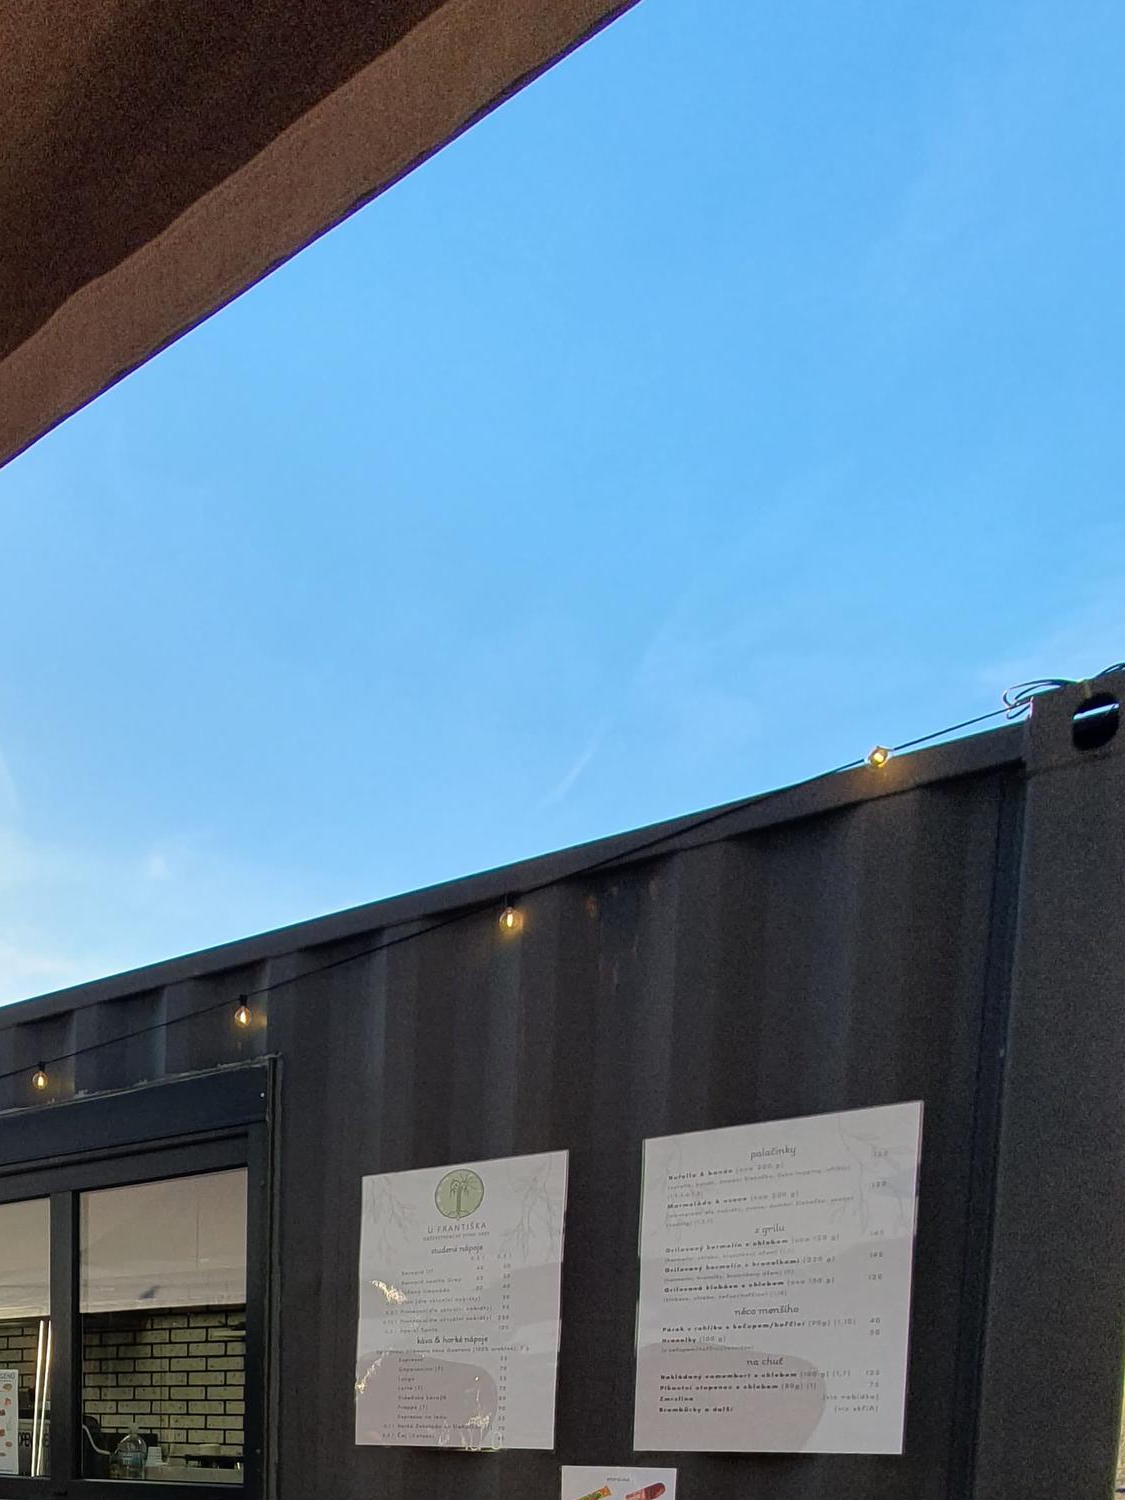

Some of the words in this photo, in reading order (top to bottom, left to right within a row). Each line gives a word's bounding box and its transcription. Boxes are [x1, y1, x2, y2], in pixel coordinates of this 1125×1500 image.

[751, 1144, 796, 1160] palačinky
[437, 1222, 487, 1233] FRANTIŠKA
[762, 1224, 785, 1237] grilu
[431, 1246, 458, 1255] studené
[459, 1243, 484, 1254] nápoje
[734, 1307, 756, 1316] něco
[759, 1304, 799, 1315] menšího
[417, 1336, 433, 1345] káva
[435, 1336, 441, 1344] &
[465, 1335, 488, 1345] nápoje
[762, 1356, 784, 1366] chuť
